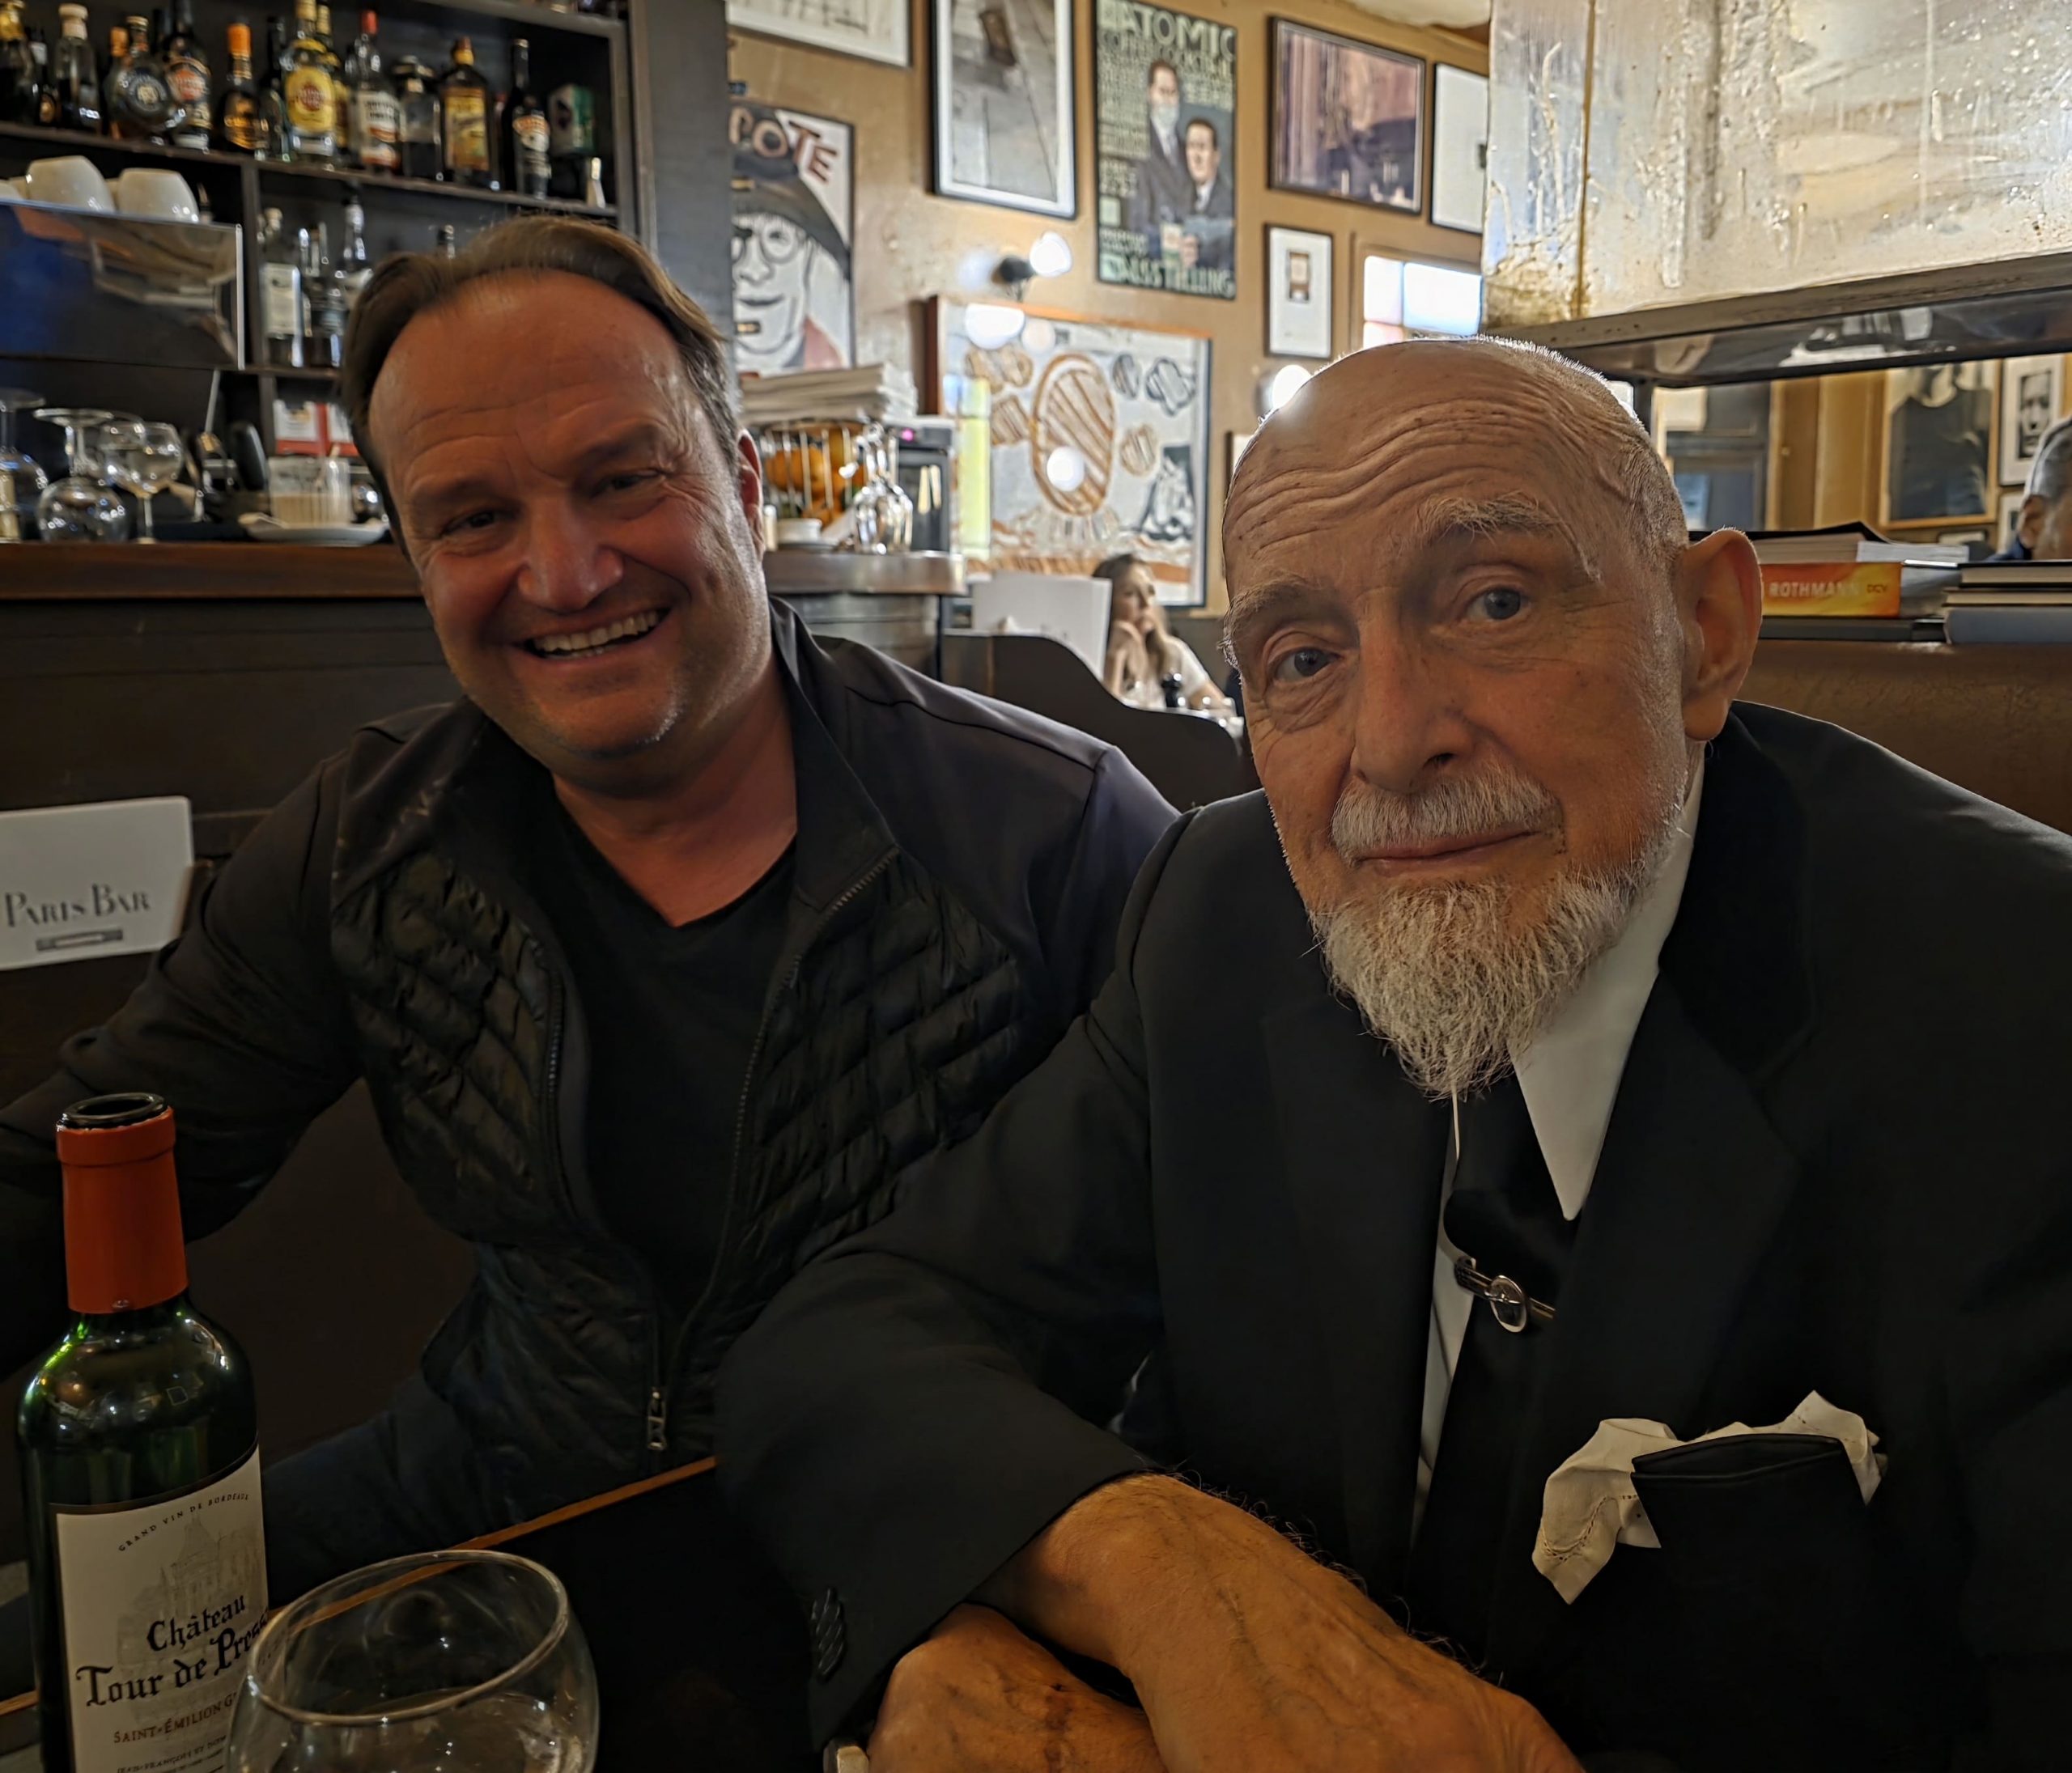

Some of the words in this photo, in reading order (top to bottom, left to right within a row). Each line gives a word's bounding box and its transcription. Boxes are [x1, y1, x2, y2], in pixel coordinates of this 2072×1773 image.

[1768, 580, 1860, 598] ROTHMANN
[5, 890, 87, 928] PARIS
[91, 883, 151, 918] BAR
[117, 1524, 157, 1552] GRAND
[162, 1510, 184, 1525] VIN
[189, 1502, 202, 1512] DE
[207, 1491, 250, 1507] BORDEAUX
[146, 1594, 246, 1652] Château
[75, 1665, 164, 1707] Tour
[174, 1657, 207, 1690] de
[210, 1608, 268, 1677] Press
[113, 1700, 222, 1743] SAINT-ÉMILION
